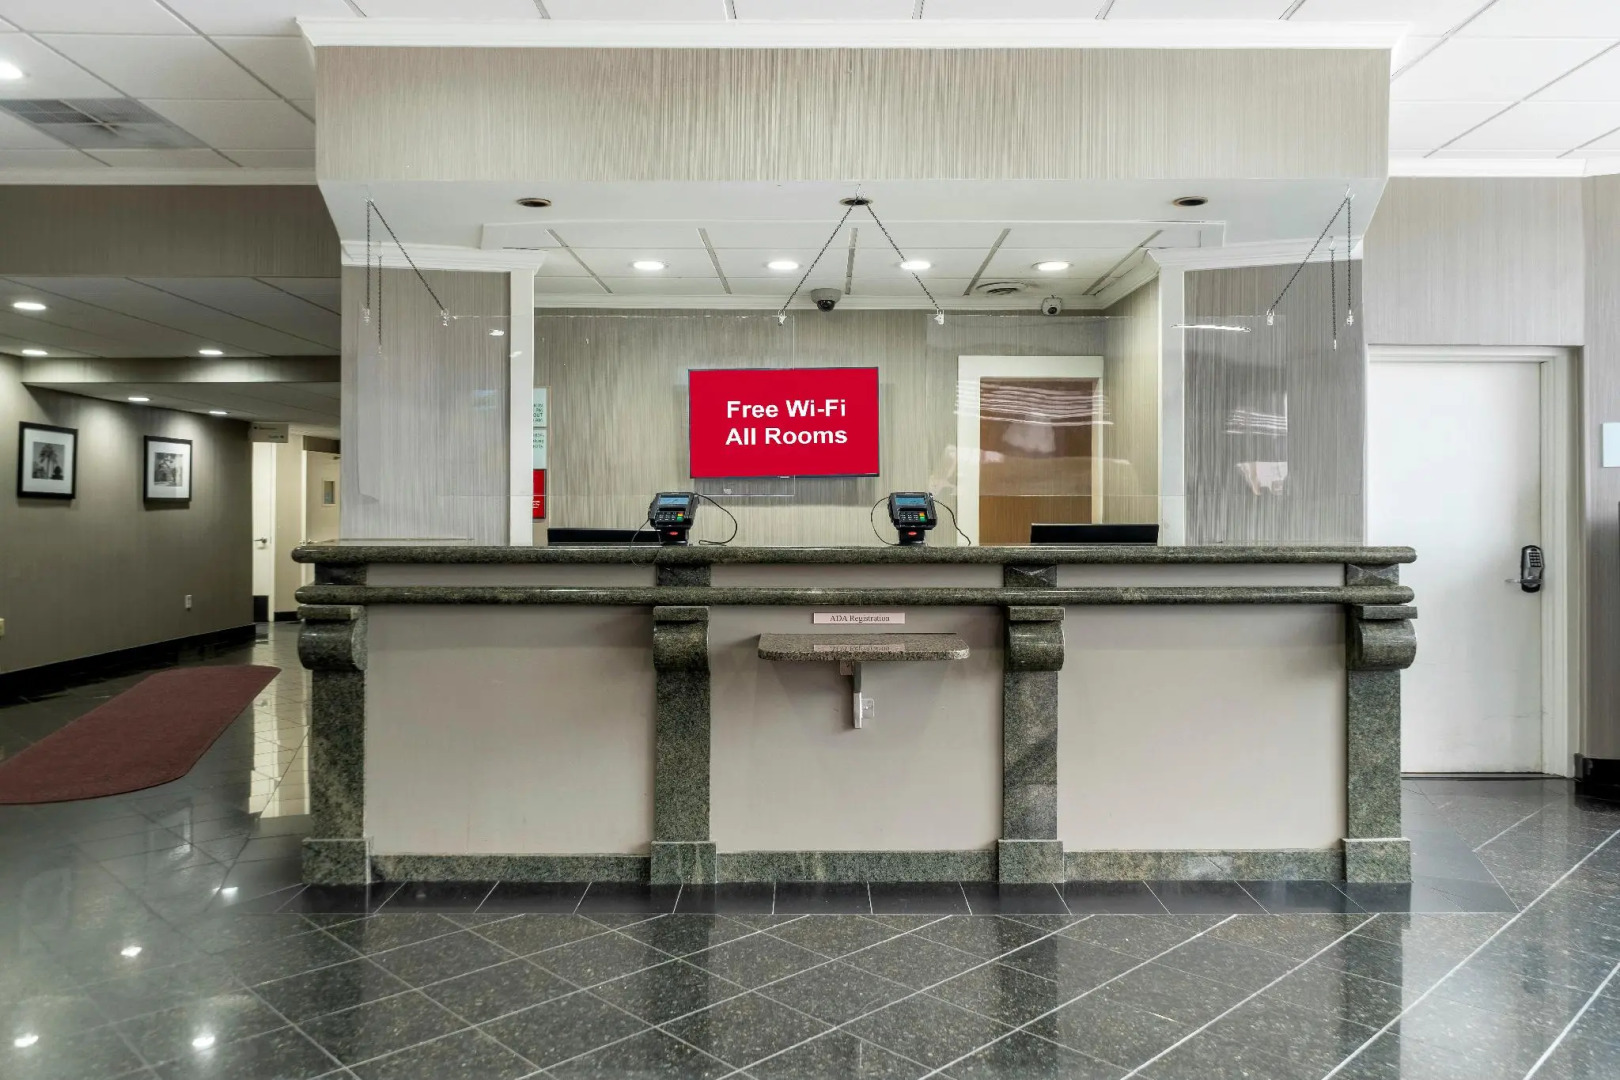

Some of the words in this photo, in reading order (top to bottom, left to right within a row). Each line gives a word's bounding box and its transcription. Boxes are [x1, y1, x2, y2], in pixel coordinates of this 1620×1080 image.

[727, 400, 779, 418] Free
[785, 399, 846, 417] Wi-Fi
[725, 427, 756, 445] All
[765, 427, 848, 445] Rooms
[849, 615, 890, 623] Registration
